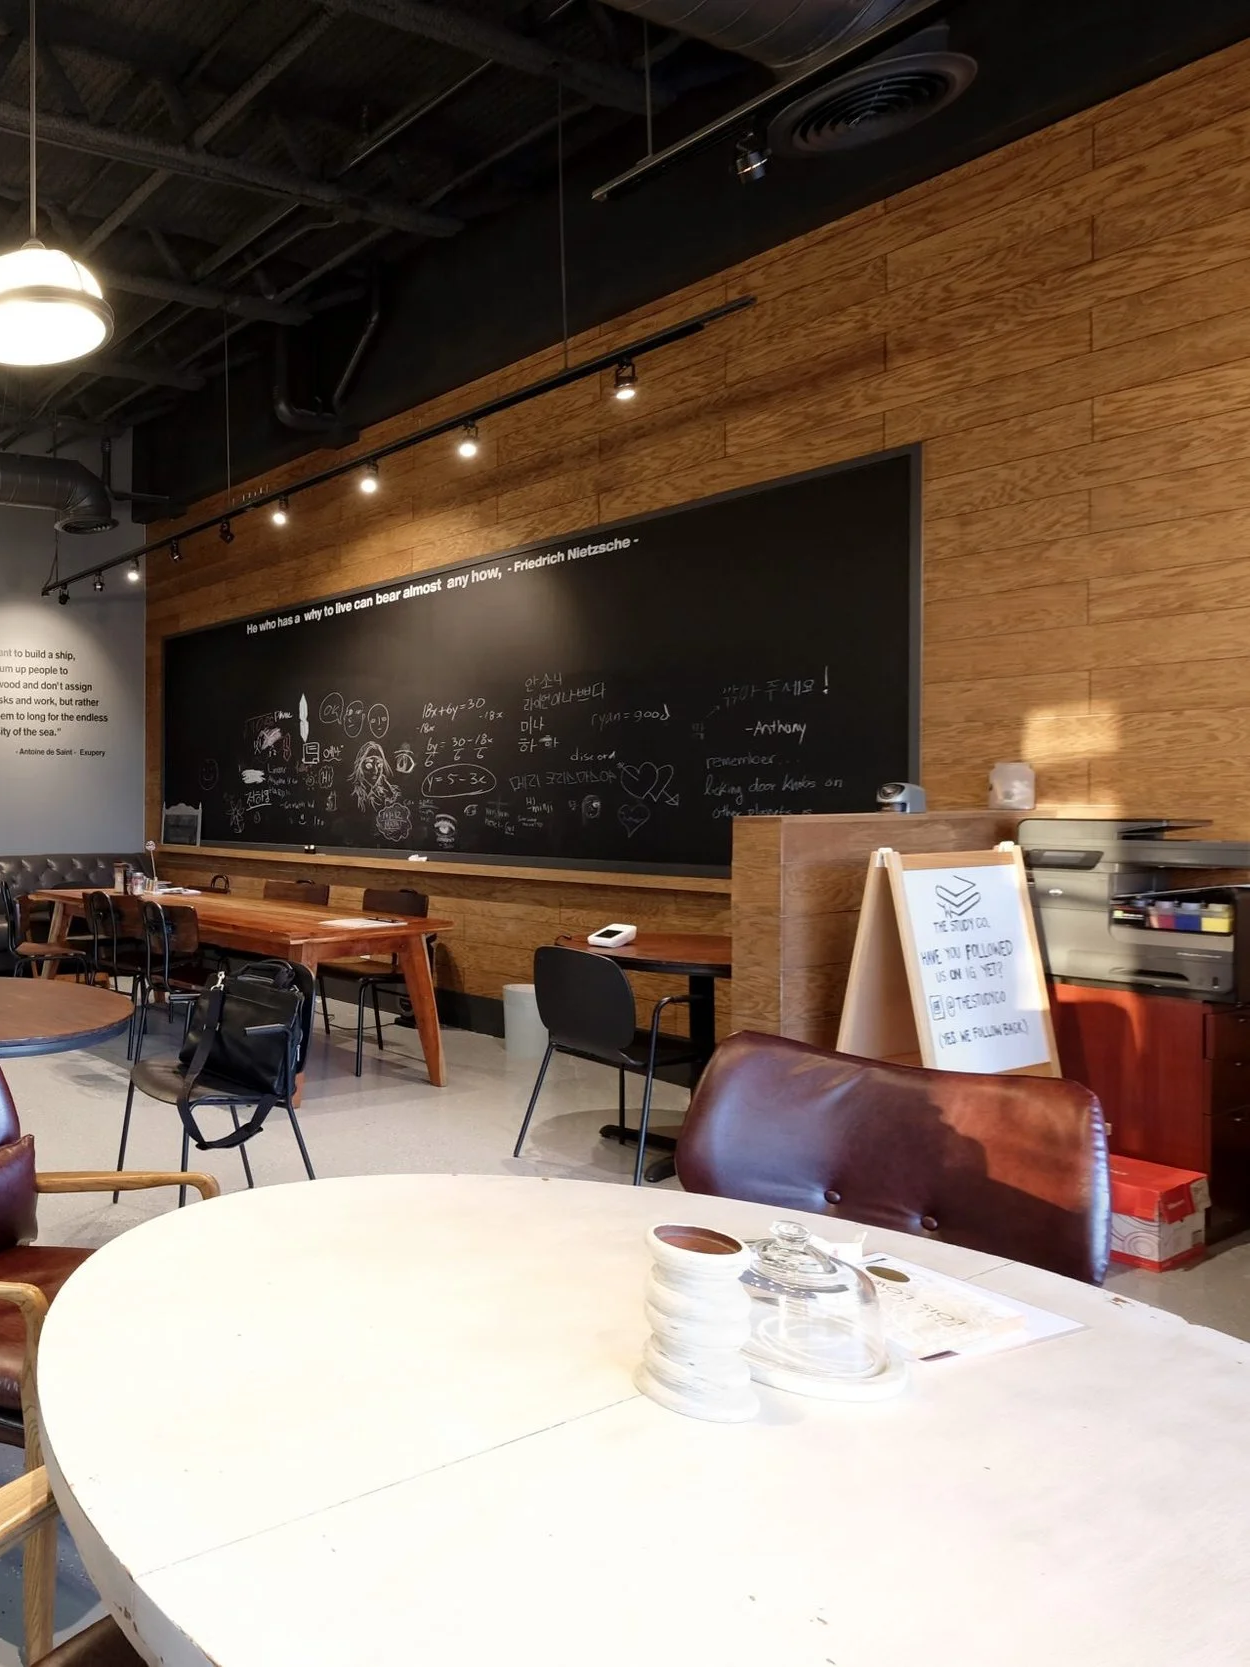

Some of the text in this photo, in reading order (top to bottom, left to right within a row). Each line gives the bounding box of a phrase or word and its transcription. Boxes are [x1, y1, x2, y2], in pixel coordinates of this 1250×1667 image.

[246, 624, 258, 635] He
[259, 620, 276, 631] who
[277, 616, 293, 628] has
[294, 614, 300, 624] a
[303, 608, 322, 622] why
[324, 605, 334, 616] to
[335, 601, 352, 614] live
[353, 596, 373, 611] can
[375, 589, 401, 605] bear
[402, 578, 442, 600] almost
[446, 573, 469, 589] any
[471, 567, 502, 583] how,
[513, 551, 565, 573] Friedrich
[567, 536, 631, 561] Nietzsche
[13, 650, 23, 658] to
[25, 649, 46, 659] build
[55, 650, 76, 661] ship,
[15, 666, 26, 675] up
[28, 666, 58, 676] people
[59, 666, 69, 675] to
[22, 681, 39, 690] and
[40, 681, 64, 691] don't
[65, 682, 92, 692] assign
[15, 696, 32, 705] and
[33, 697, 57, 706] work,
[59, 697, 74, 706] but
[74, 698, 100, 707] rather
[323, 704, 340, 716] OK
[632, 703, 671, 723] good
[16, 712, 25, 720] to
[26, 712, 46, 722] long
[48, 712, 59, 721] for
[61, 713, 75, 722] the
[76, 714, 108, 722] endless
[12, 727, 22, 736] of
[23, 728, 37, 736] the
[19, 748, 45, 756] Antoine
[933, 919, 948, 933] THE
[949, 918, 974, 932] STUDY
[920, 939, 1014, 966] HAVE YOU FOLLOWED
[935, 961, 1004, 983] US ON IG YET?
[961, 1029, 972, 1043] WE
[972, 1023, 1002, 1039] FOLLOW
